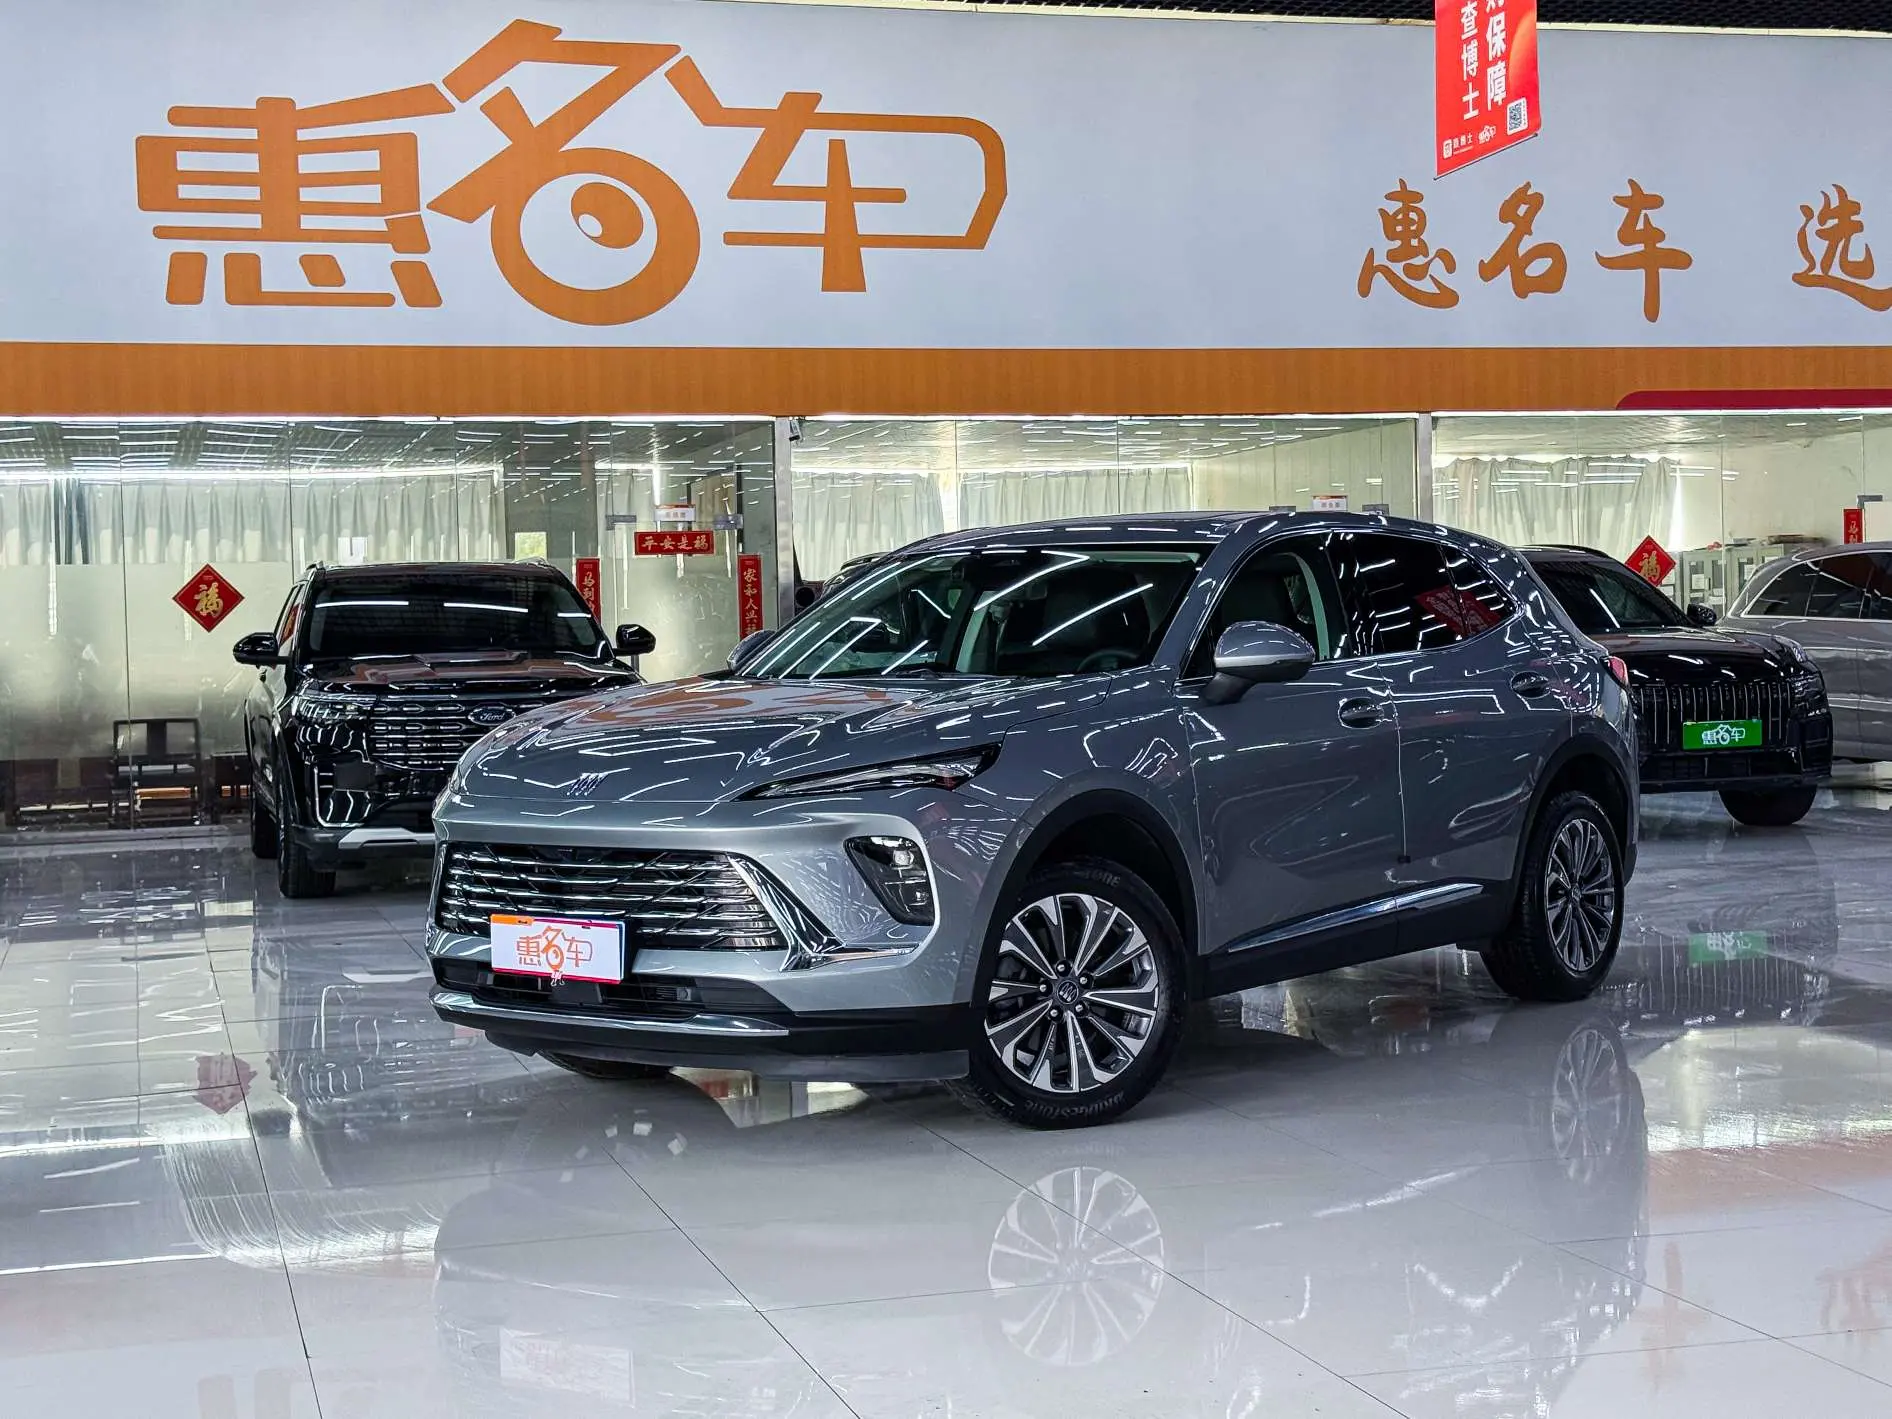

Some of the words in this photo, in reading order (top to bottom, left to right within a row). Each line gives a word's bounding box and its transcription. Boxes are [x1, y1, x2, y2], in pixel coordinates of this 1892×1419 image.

[1460, 1, 1480, 120] 查博士
[135, 18, 1008, 326] 惠名车
[1357, 178, 1693, 323] 惠名车
[1792, 183, 1892, 312] 选
[641, 534, 709, 550] 平安是福
[1638, 550, 1662, 582] 福
[193, 581, 224, 618] 福
[480, 712, 506, 721] Ford
[516, 925, 594, 971] 惠名车
